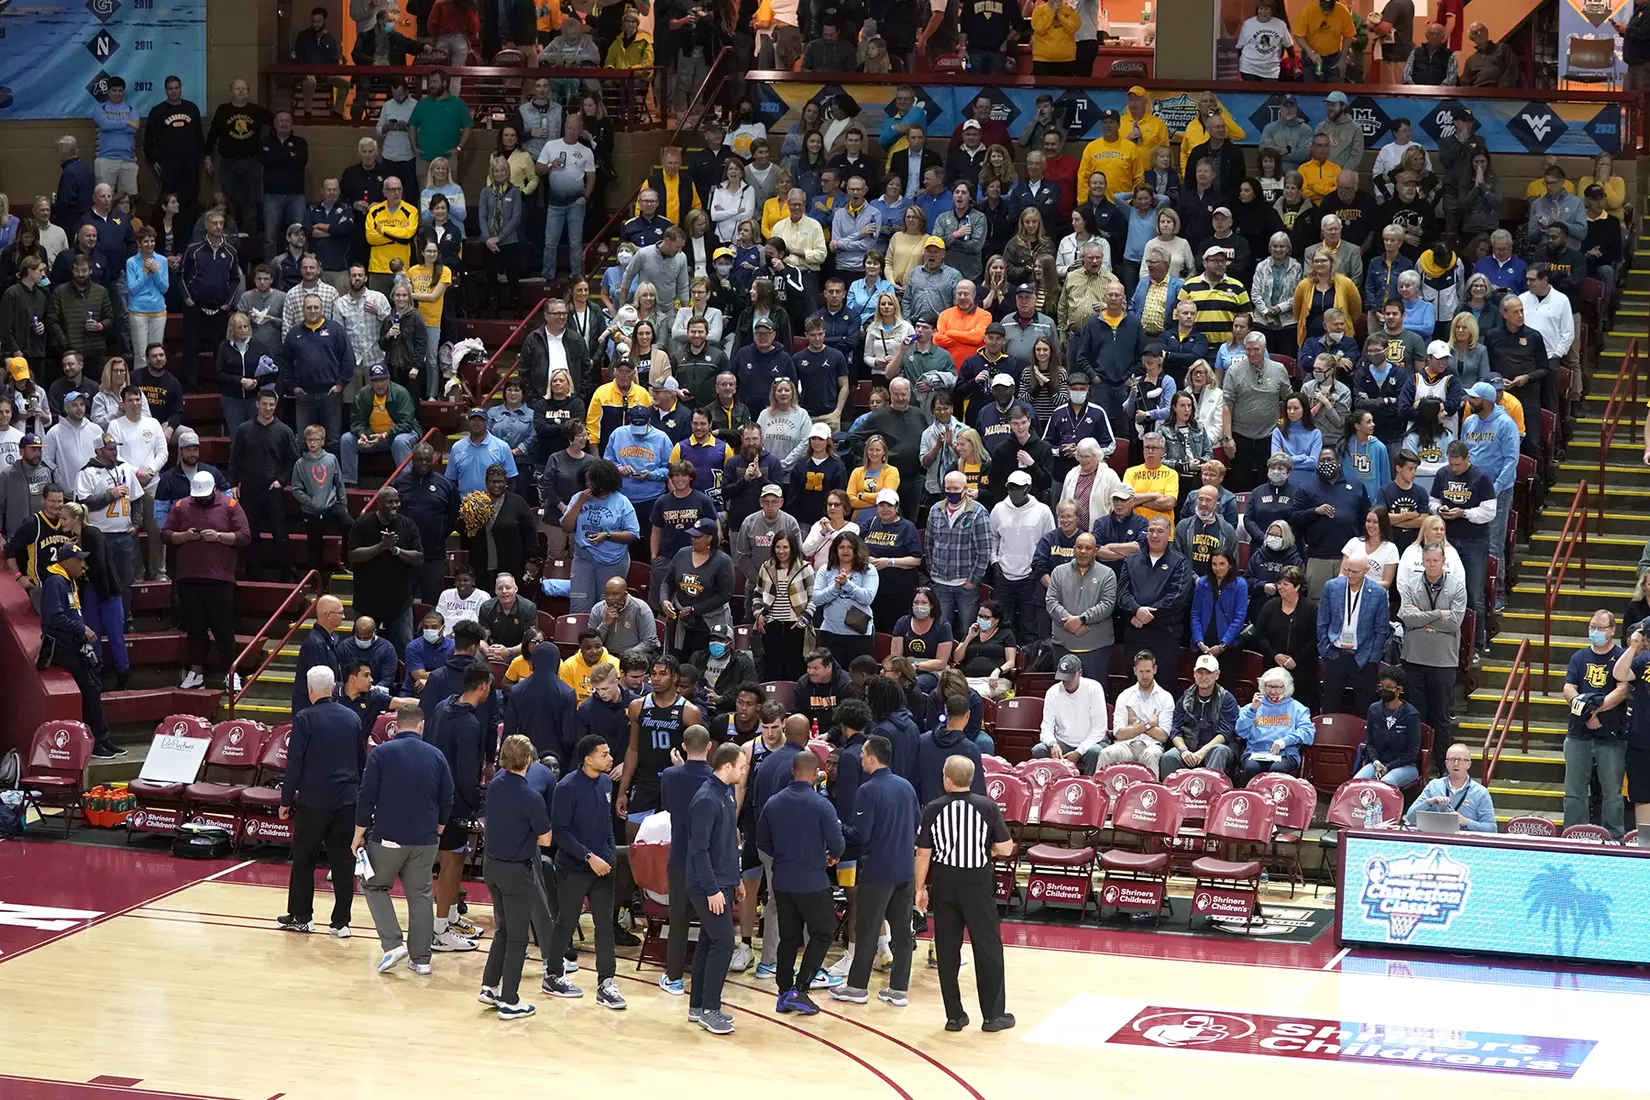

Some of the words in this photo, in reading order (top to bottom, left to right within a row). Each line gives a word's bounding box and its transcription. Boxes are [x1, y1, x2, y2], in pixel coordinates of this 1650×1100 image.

[97, 37, 109, 56] N
[134, 41, 153, 50] 2011
[134, 82, 153, 92] 2012
[760, 102, 780, 112] 2021
[1436, 111, 1453, 125] Ole
[1594, 123, 1616, 135] 2021
[1093, 150, 1124, 161] MARQUETTE
[767, 417, 797, 431] MARQUETTE
[984, 424, 1011, 437] MARQUET
[619, 446, 655, 462] MARQUETTE
[1352, 453, 1372, 473] MU
[805, 471, 824, 491] M
[1133, 470, 1170, 481] MARQUETTE
[581, 505, 614, 519] MARQUETTE
[51, 547, 63, 561] 2
[1584, 663, 1609, 688] MU
[641, 717, 680, 730] Marquette
[651, 731, 670, 749] 10
[50, 748, 70, 756] Shriners
[1060, 803, 1083, 811] Shriners
[1134, 808, 1157, 817] Shriners
[147, 813, 175, 823] Shriners
[1131, 813, 1158, 822] Children's
[1225, 816, 1248, 824] Shriners
[205, 819, 234, 829] Shriners
[260, 820, 289, 831] Shriners
[1223, 822, 1250, 830] Children's
[1513, 821, 1542, 830] COLLEGE
[258, 828, 291, 838] Children's
[1507, 826, 1552, 837] CHARLESTON
[1571, 830, 1597, 838] COLLEGE
[1046, 883, 1079, 893] Shriners
[1120, 888, 1154, 898] Shriners
[1365, 881, 1463, 906] Charleston
[1045, 889, 1081, 900] Children's
[1119, 895, 1156, 905] Children's
[1212, 895, 1246, 906] Shriners
[1211, 903, 1248, 913] Children's
[1380, 898, 1441, 917] Classic
[1270, 1021, 1541, 1055] Shriners
[1259, 1035, 1558, 1071] Children's
